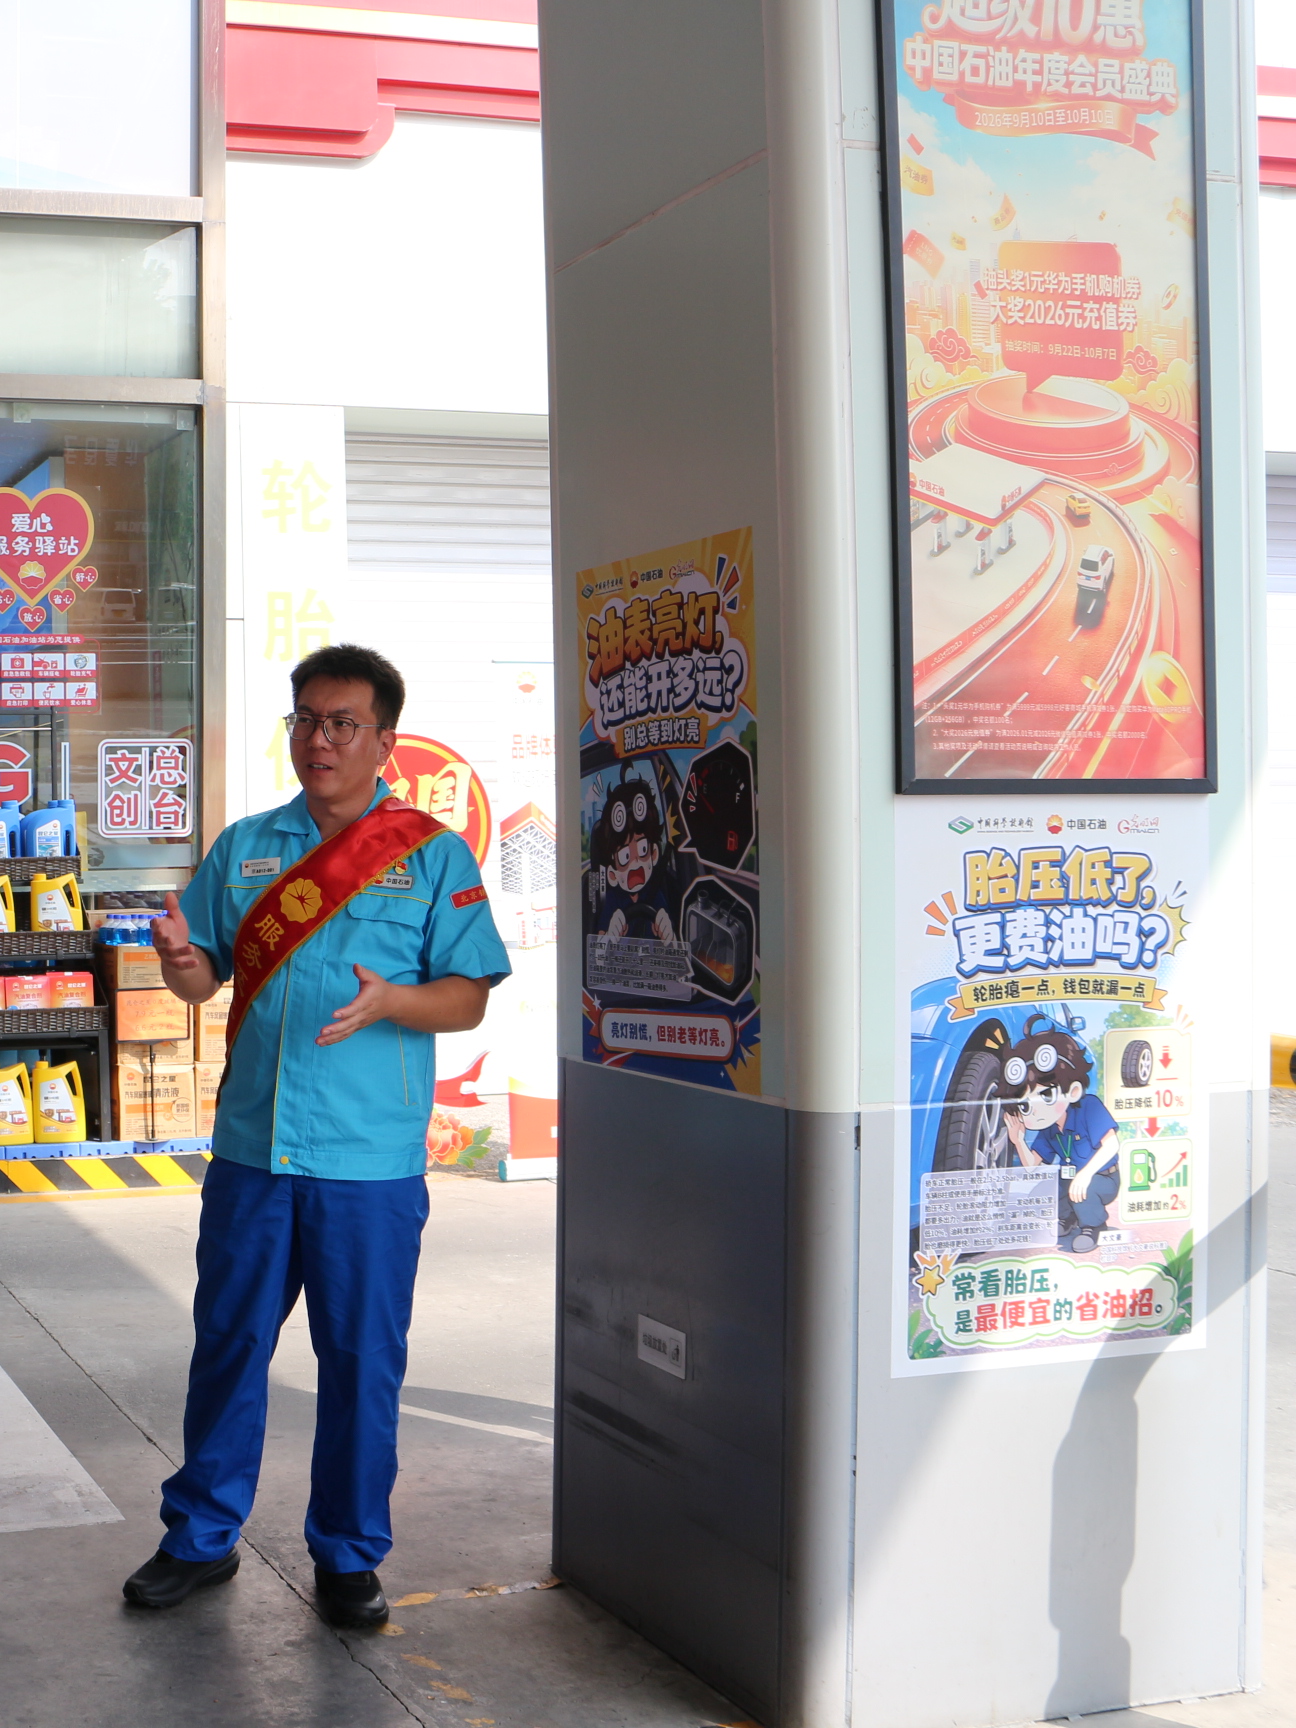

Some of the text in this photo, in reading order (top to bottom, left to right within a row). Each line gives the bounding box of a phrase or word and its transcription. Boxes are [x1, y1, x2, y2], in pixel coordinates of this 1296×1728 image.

[905, 36, 1178, 104] 中国石油年度会员盛典
[975, 108, 1114, 128] 2026年9月10日至10月10日
[983, 268, 1141, 300] 抽头奖1元华为手机购机券
[990, 296, 1138, 332] 大奖2026元充值券
[11, 513, 53, 533] 爱心
[640, 568, 664, 583] 中国石油
[52, 594, 74, 605] 省心
[22, 611, 44, 623] 放心
[260, 459, 336, 791] 轮胎
[512, 734, 556, 759] 品牌体
[624, 718, 700, 751] 别总等到灯亮
[105, 751, 142, 828] 文创
[149, 746, 187, 829] 总台
[1066, 818, 1108, 831] 中国石油
[385, 877, 411, 886] 中国石油
[952, 1267, 1059, 1303] 常看胎压，
[954, 1287, 1164, 1335] 是最便宜的省油招。
